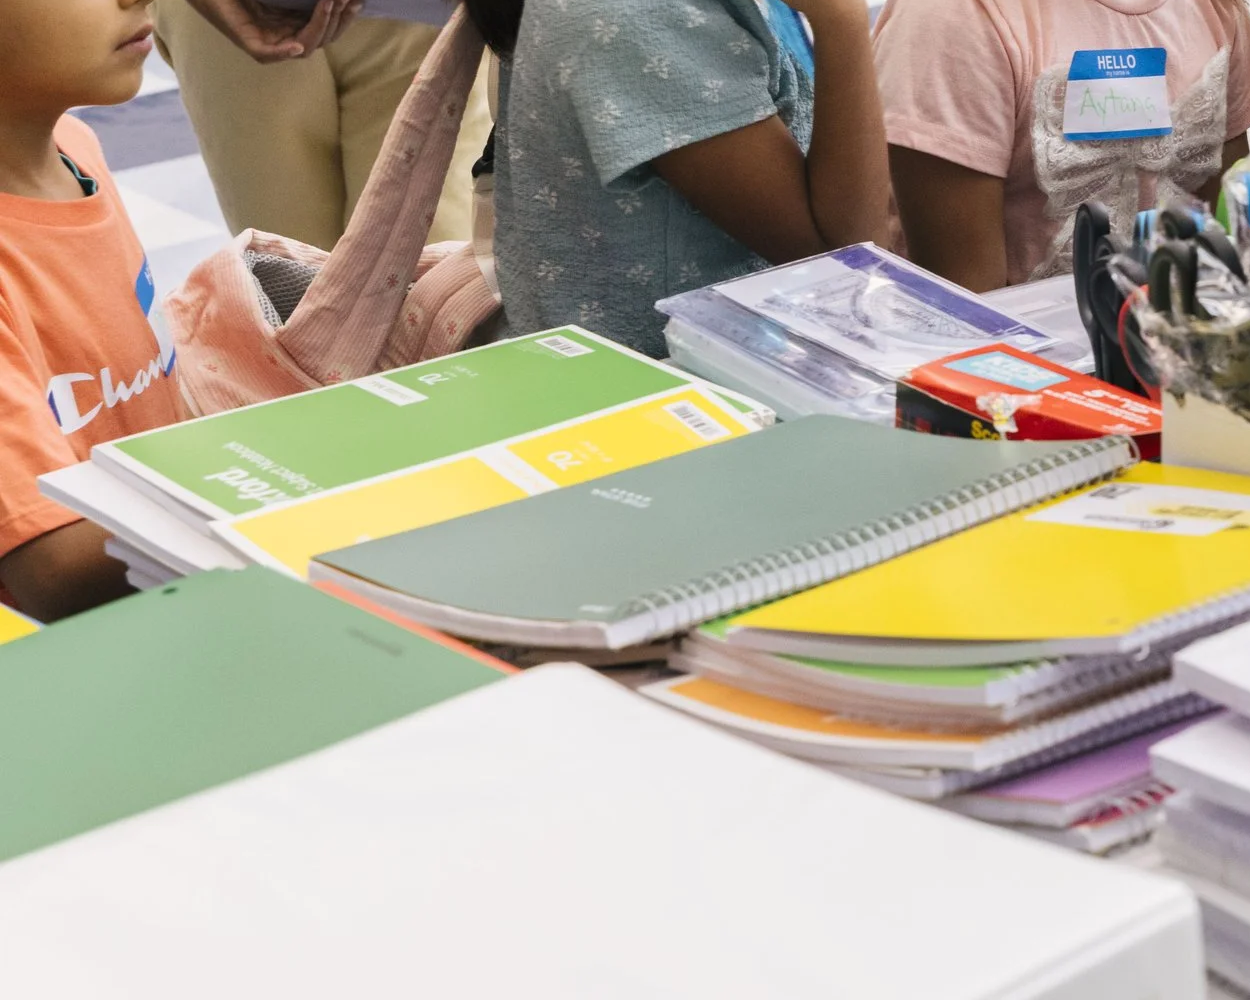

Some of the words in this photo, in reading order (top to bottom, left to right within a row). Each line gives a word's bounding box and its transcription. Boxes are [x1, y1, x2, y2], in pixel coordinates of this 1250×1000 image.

[1097, 54, 1136, 70] HELLO
[417, 373, 446, 385] 70
[971, 419, 1001, 440] Sco
[222, 441, 271, 470] Notebook
[547, 450, 582, 471] 70
[204, 466, 301, 507] xford
